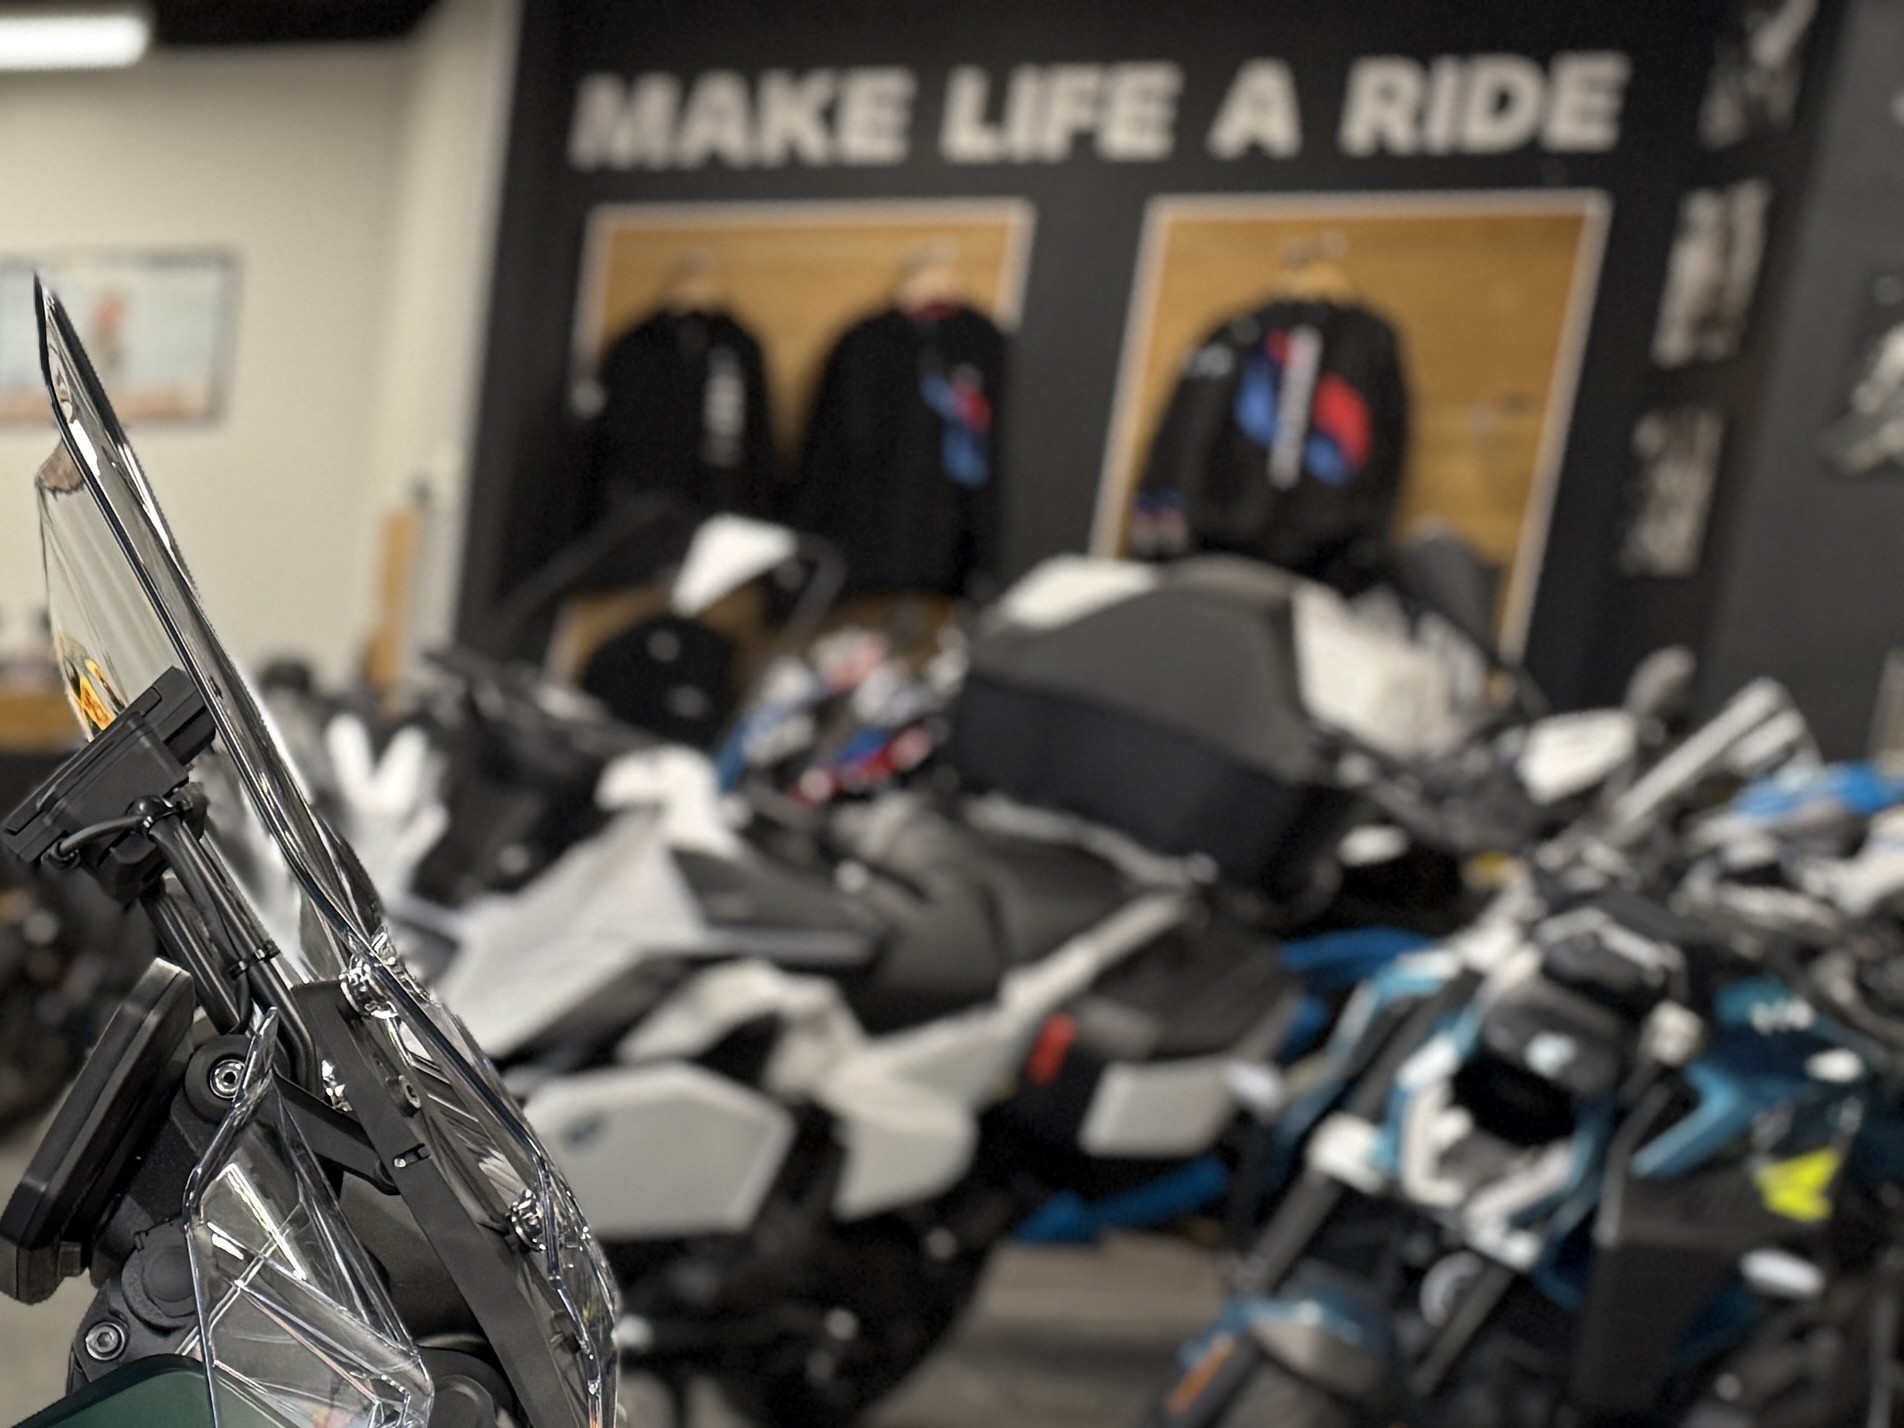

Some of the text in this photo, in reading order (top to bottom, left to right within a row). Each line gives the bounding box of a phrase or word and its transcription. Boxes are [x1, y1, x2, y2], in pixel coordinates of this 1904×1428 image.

[569, 52, 1629, 166] MAKE LIFE A RIDE
